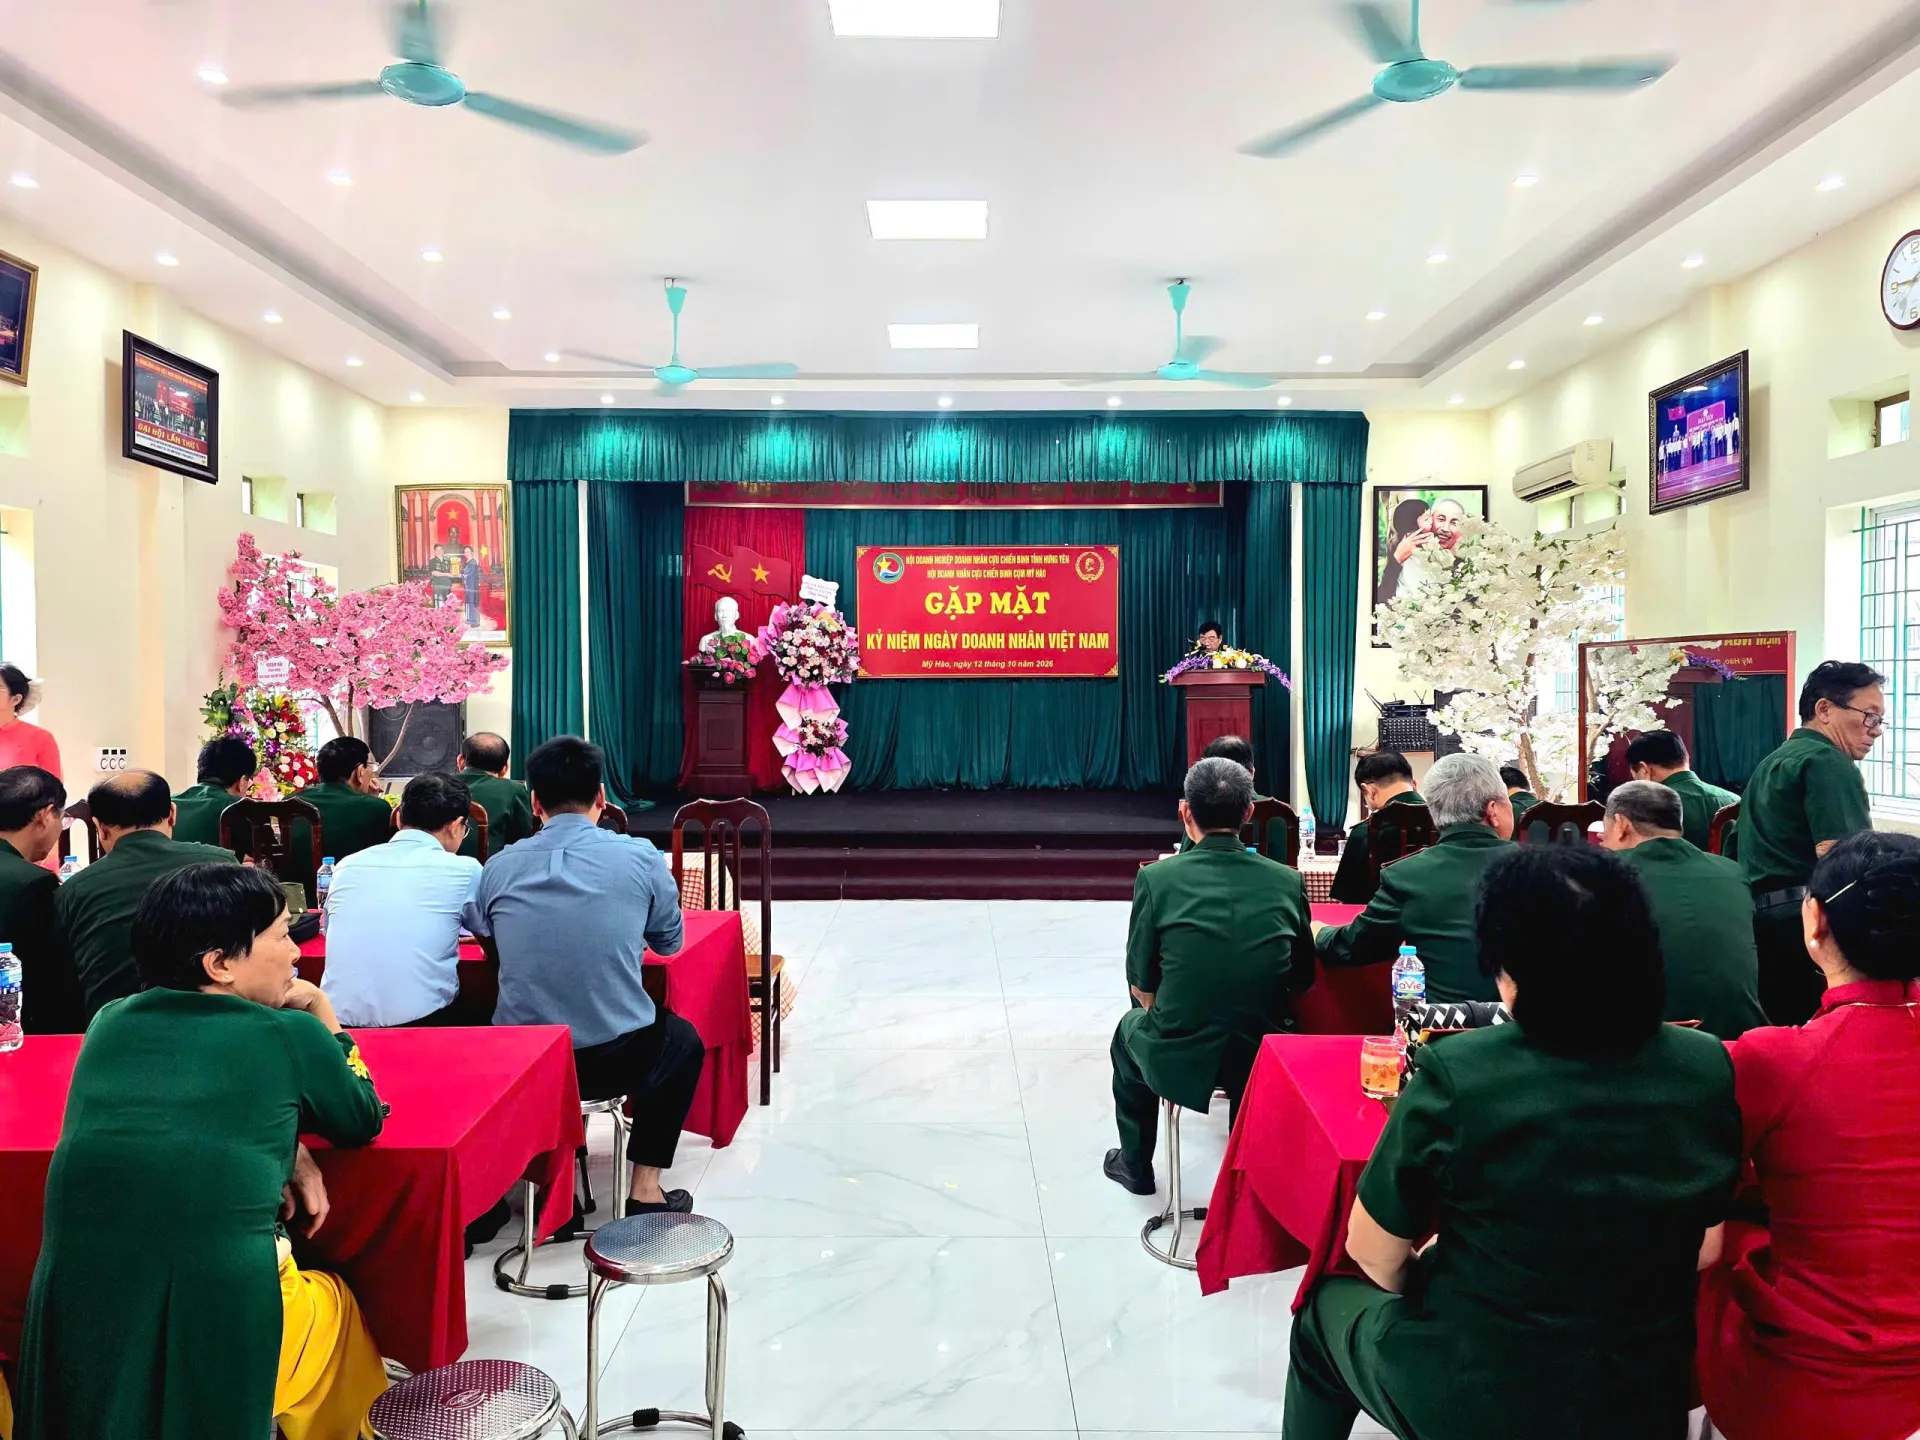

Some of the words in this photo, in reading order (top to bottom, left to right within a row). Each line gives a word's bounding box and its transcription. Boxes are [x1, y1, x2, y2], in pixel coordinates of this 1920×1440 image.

[924, 584, 982, 621] GẶP
[989, 584, 1051, 621] MẶT
[866, 628, 883, 650] KỶ
[886, 630, 920, 653] NIỆM
[923, 630, 958, 649] NGÀY
[961, 633, 1004, 649] DOANH
[1008, 630, 1045, 649] NHÂN
[1048, 630, 1076, 652] VIỆT
[1078, 633, 1109, 649] NAM
[921, 660, 934, 669] Mỹ
[935, 660, 952, 669] Hào,
[953, 661, 972, 669] ngày
[984, 660, 1006, 669] tháng
